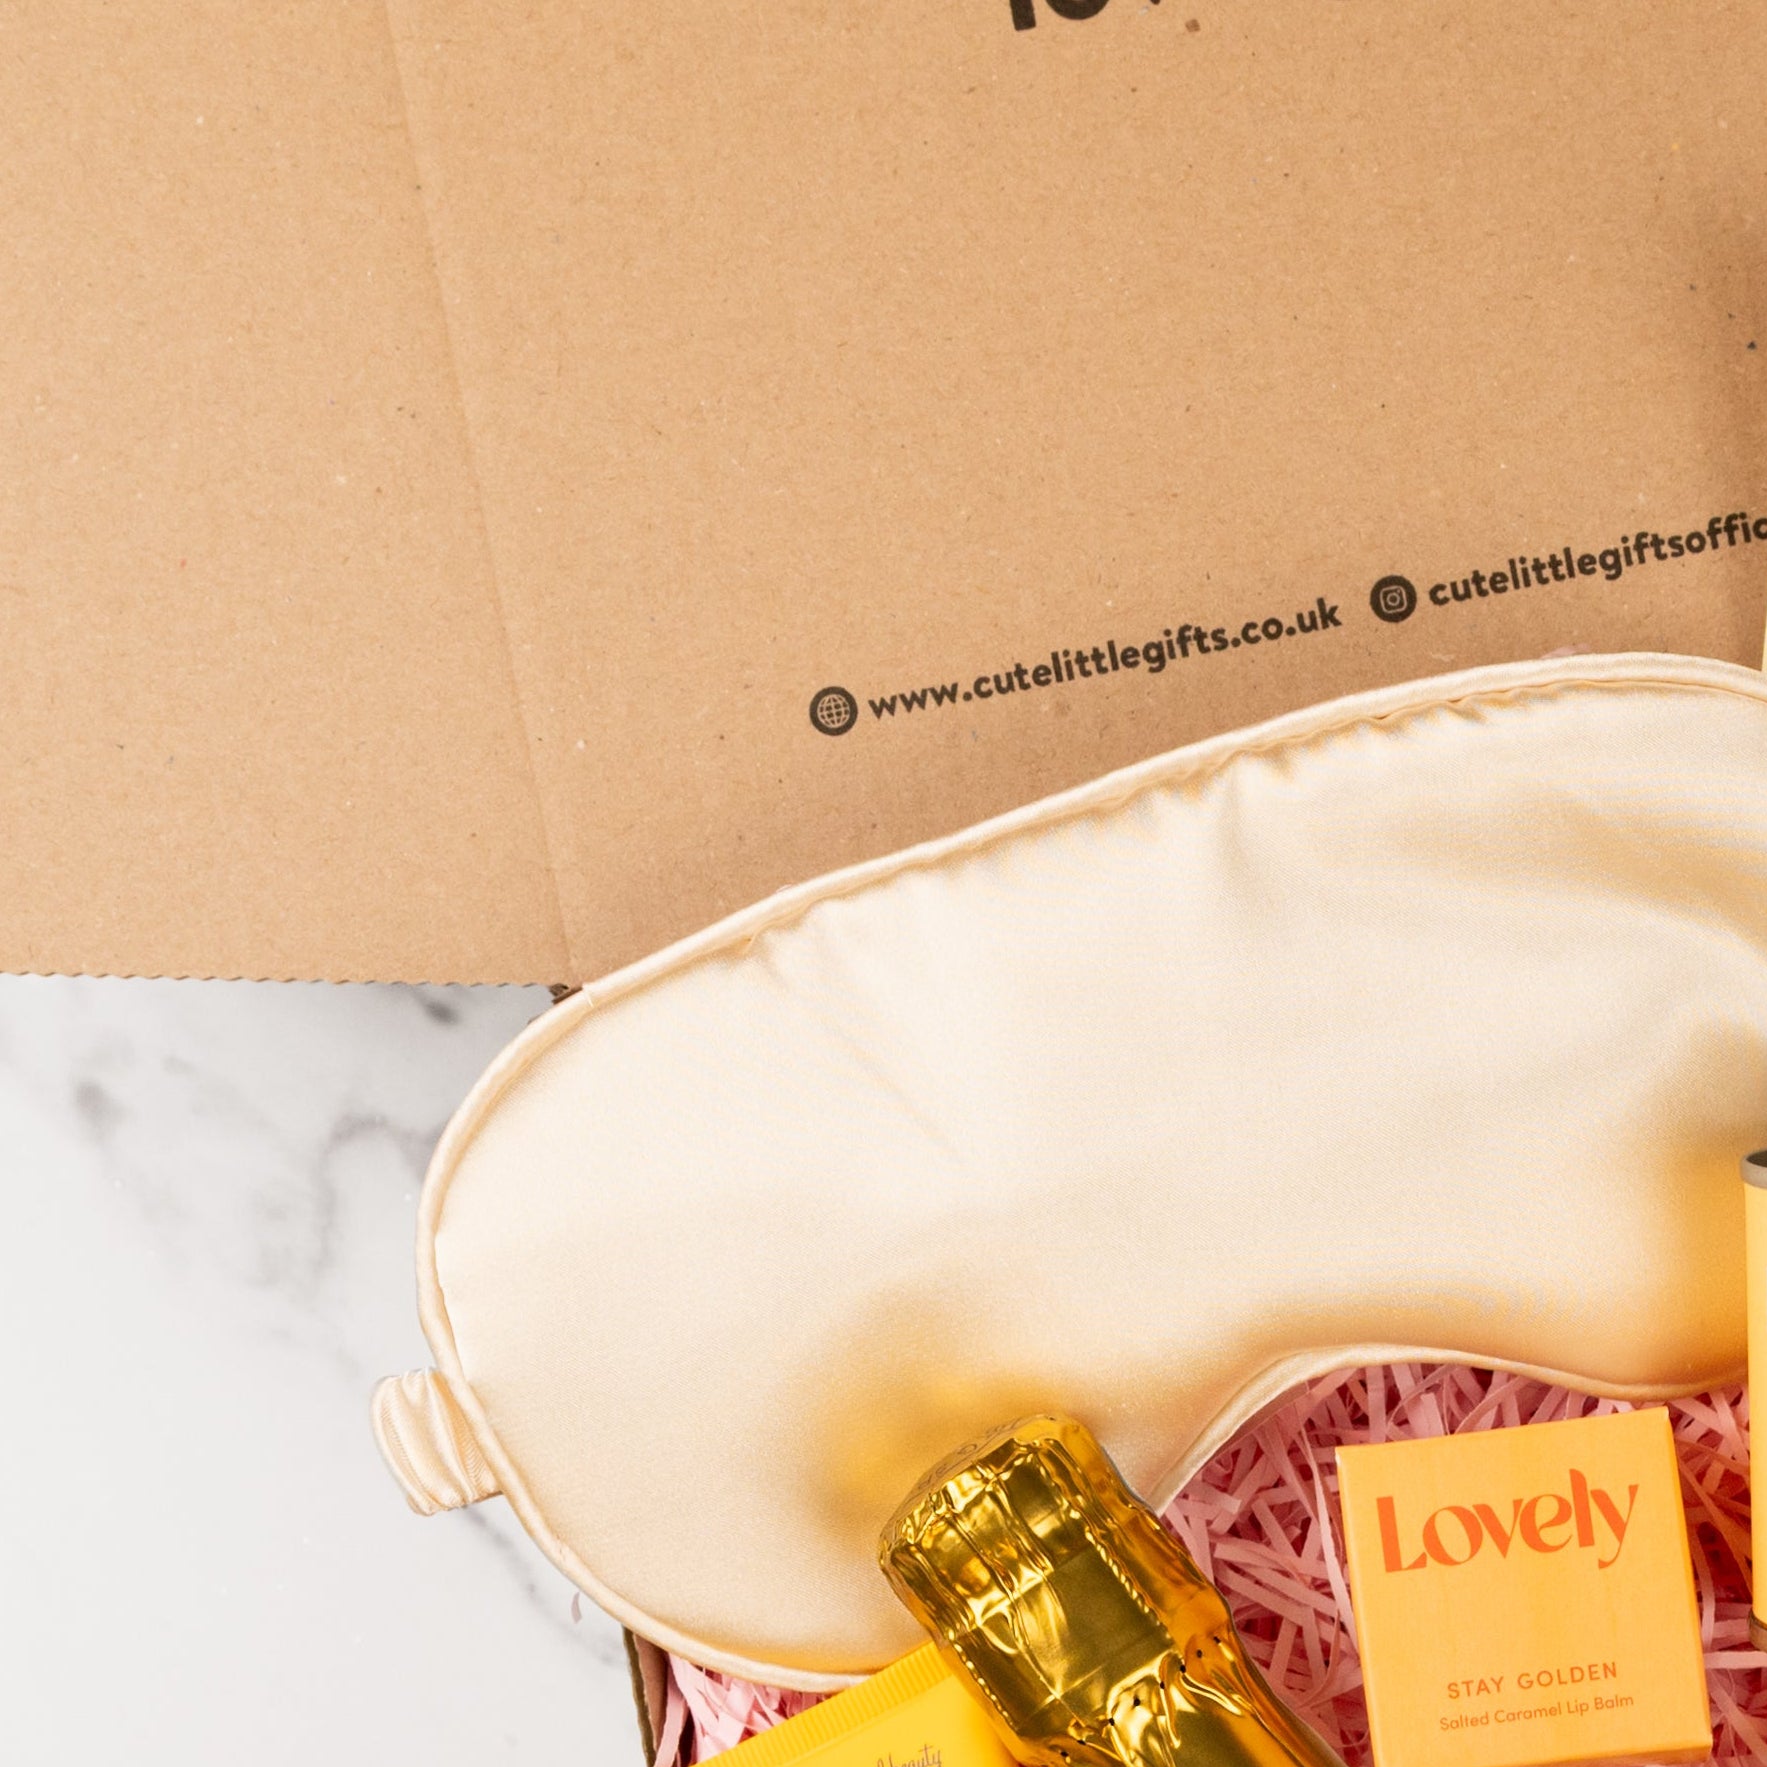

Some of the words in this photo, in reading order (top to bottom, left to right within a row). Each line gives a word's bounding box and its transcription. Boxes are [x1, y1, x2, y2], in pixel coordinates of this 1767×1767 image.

[868, 597, 1342, 720] www.cutelittlegifts.co.uk
[1376, 1468, 1639, 1573] Lovely
[1439, 1711, 1489, 1731] Salted
[1494, 1703, 1562, 1724] Caramel
[1567, 1700, 1589, 1717] Lip
[1594, 1695, 1634, 1711] Balm
[1447, 1676, 1504, 1699] STAY
[1517, 1662, 1617, 1690] GOLDEN
